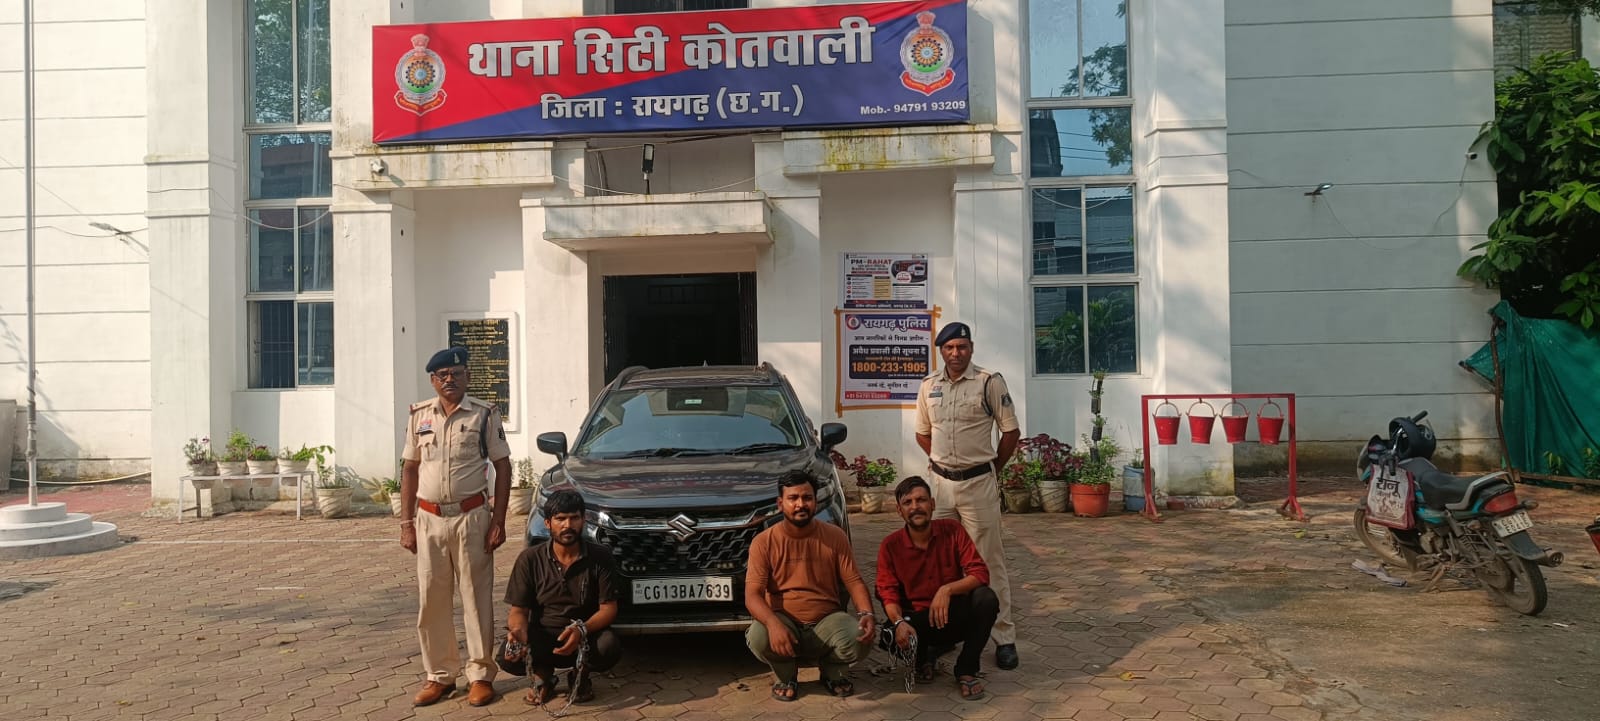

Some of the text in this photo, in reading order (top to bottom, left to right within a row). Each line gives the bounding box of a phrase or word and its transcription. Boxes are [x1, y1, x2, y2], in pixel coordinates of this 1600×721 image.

[468, 16, 876, 77] थाना सिटी कोतवाली
[540, 93, 606, 119] जिला
[631, 94, 710, 121] रायगढ़
[716, 84, 804, 120] (छ.ग.)
[894, 102, 928, 113] 94791
[931, 100, 966, 111] 93209
[898, 316, 928, 331] पुलिस
[852, 362, 926, 373] 1800-233-1905
[644, 584, 730, 600] CG13BA7639
